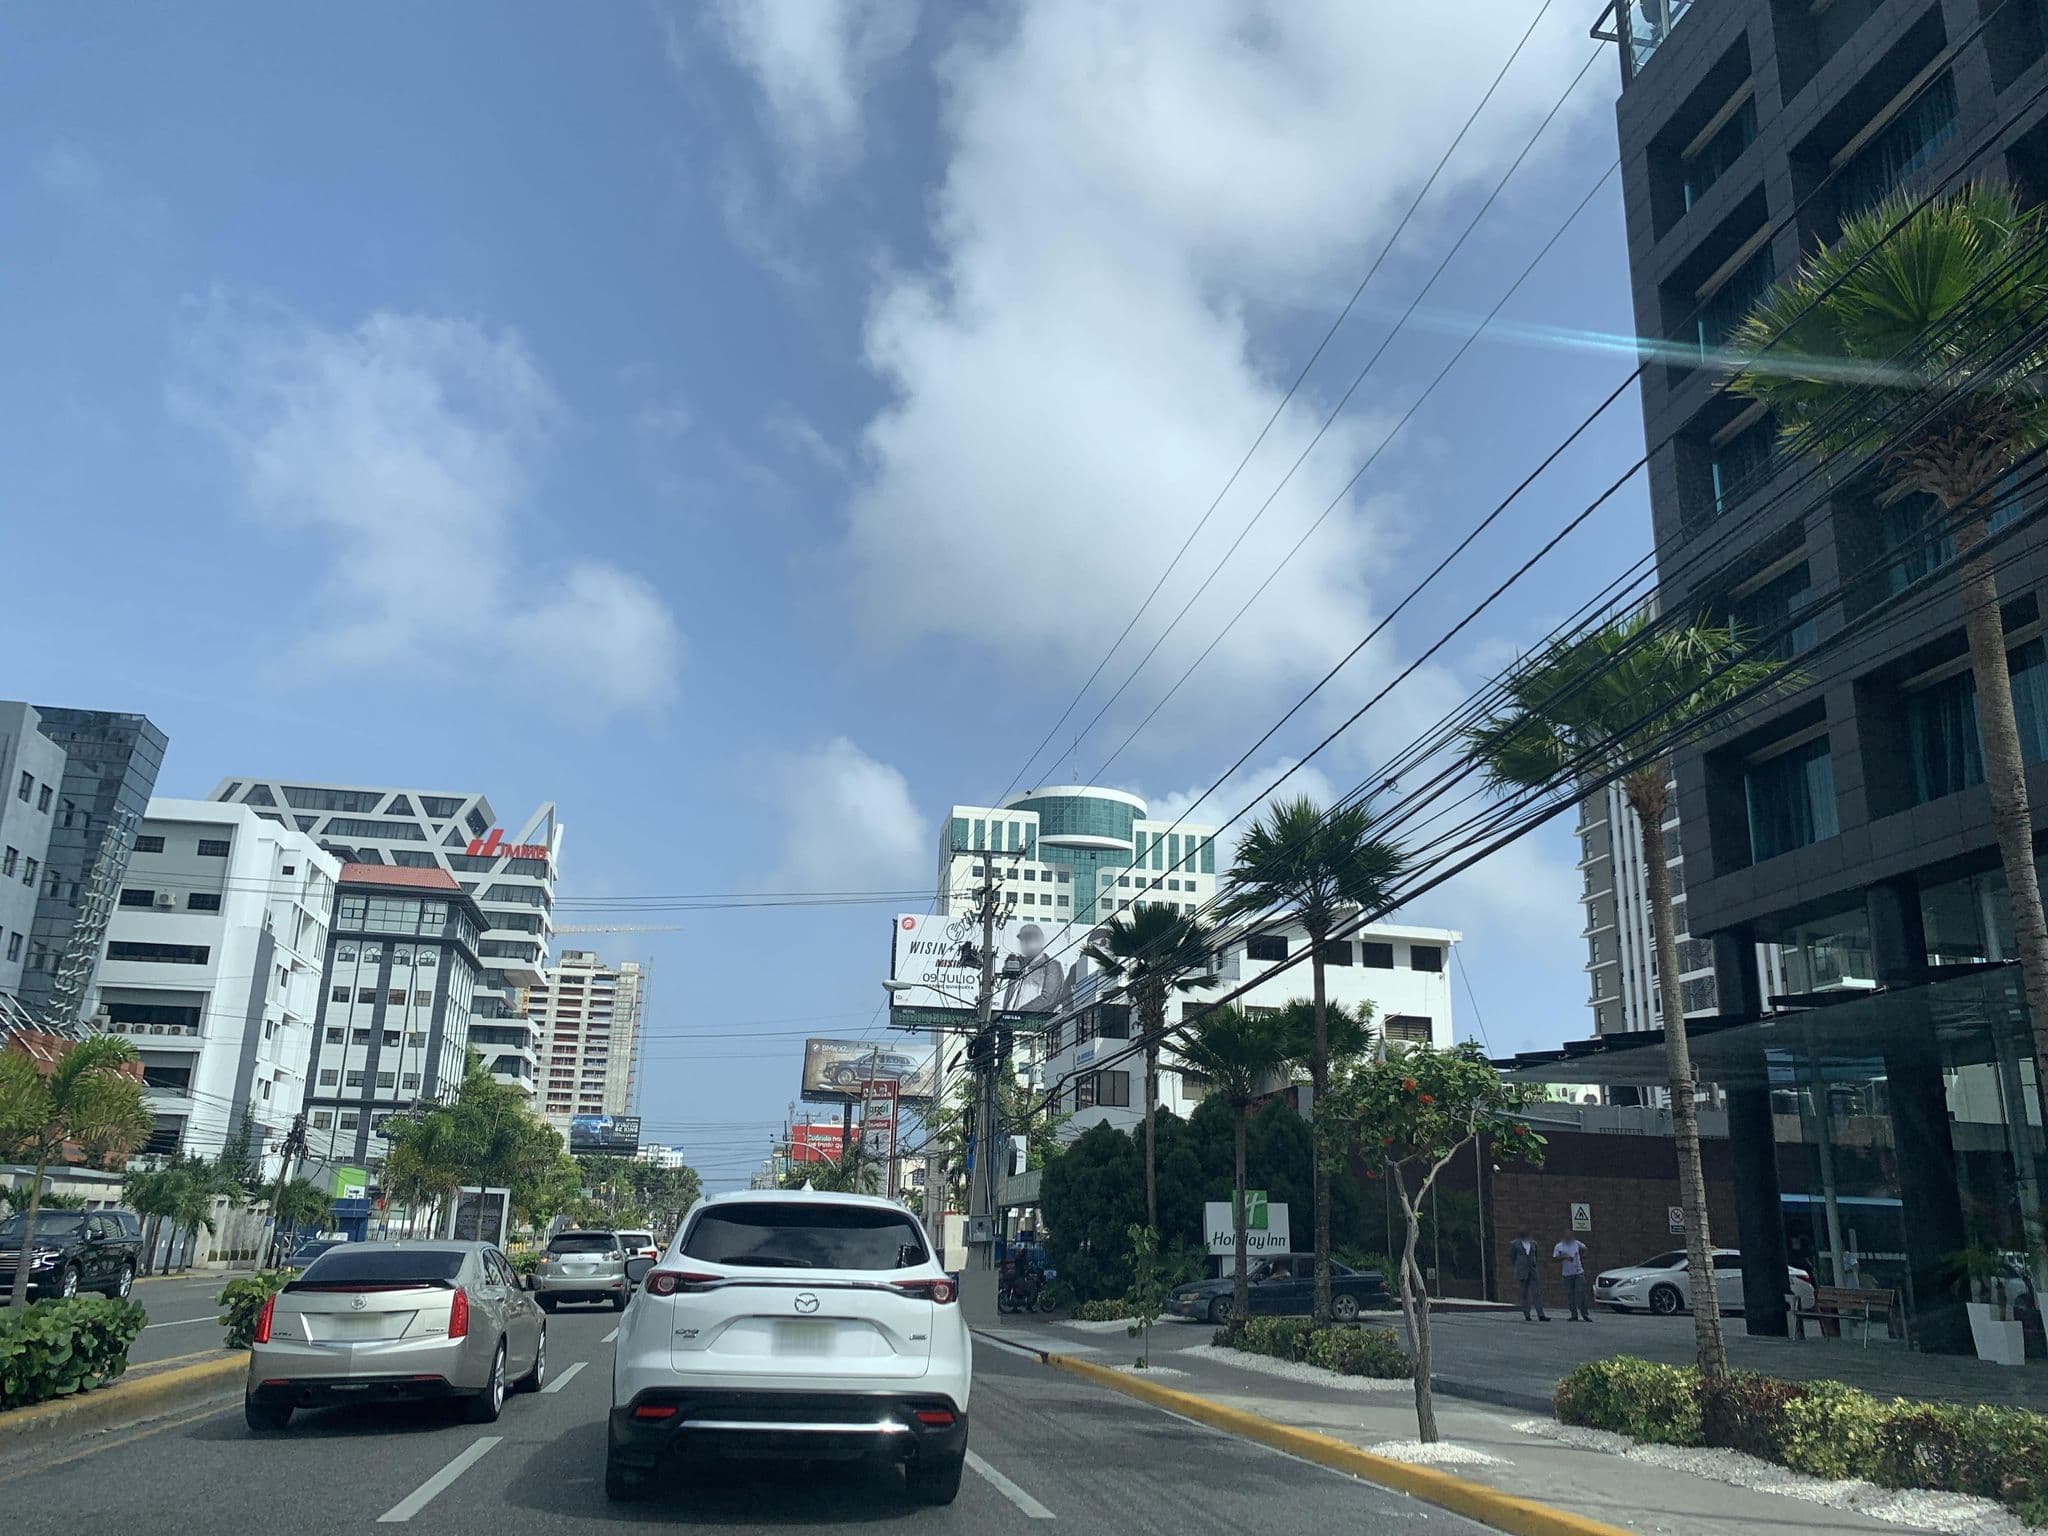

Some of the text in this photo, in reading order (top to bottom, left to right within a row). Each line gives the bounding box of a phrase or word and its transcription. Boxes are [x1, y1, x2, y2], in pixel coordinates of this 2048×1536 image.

[909, 941, 947, 956] WISIN
[922, 973, 975, 985] 09 JULIO
[1213, 1231, 1286, 1250] Holay Inn
